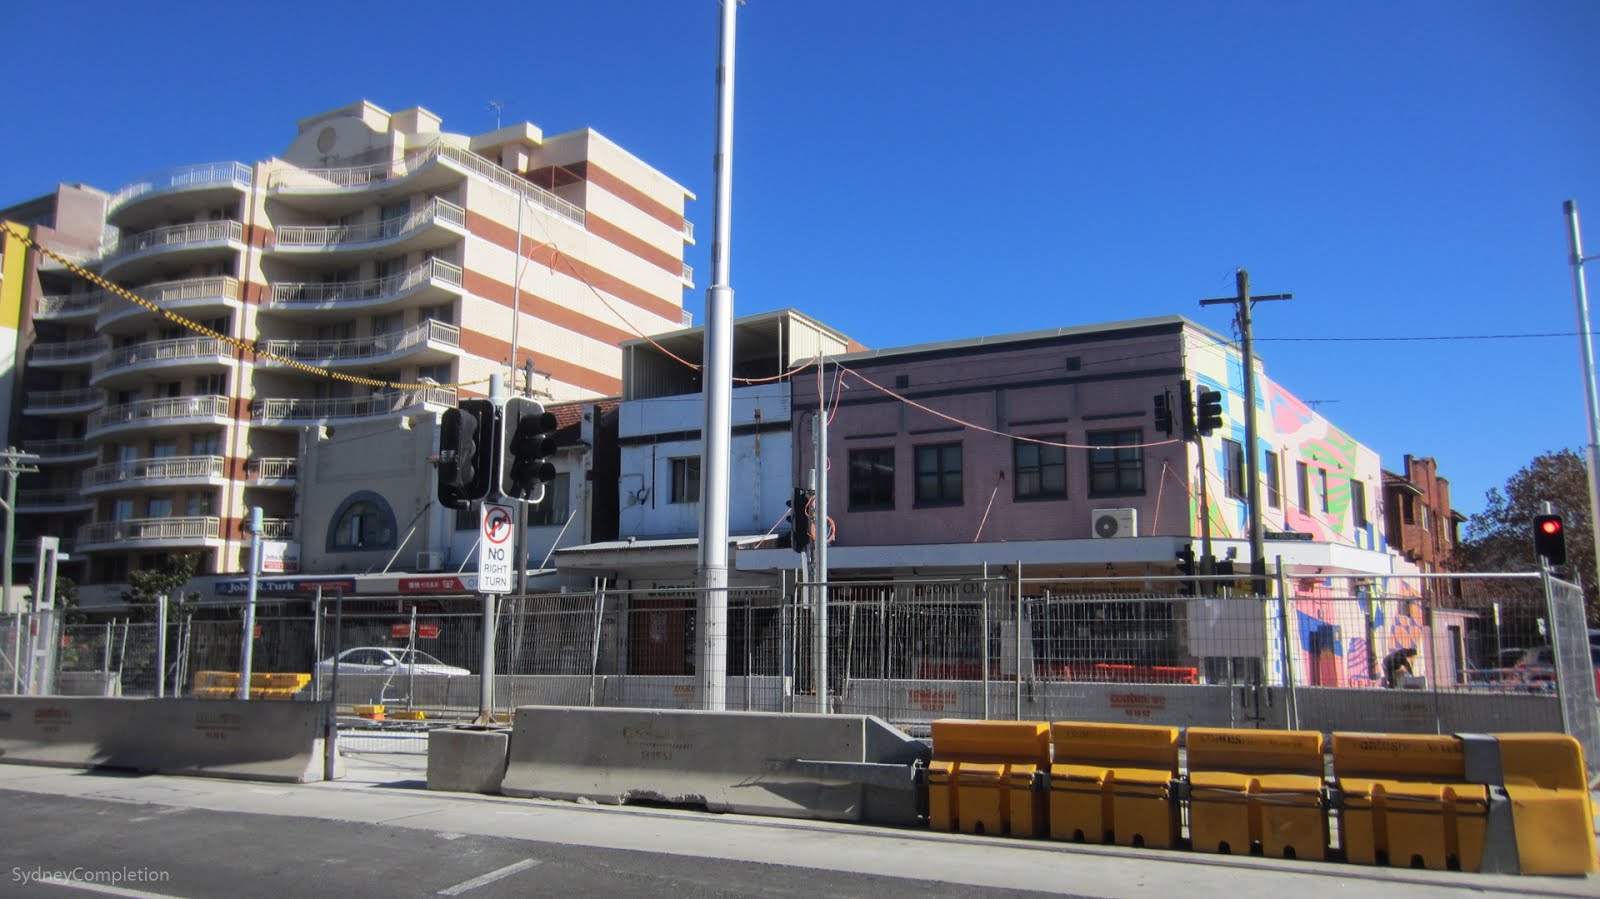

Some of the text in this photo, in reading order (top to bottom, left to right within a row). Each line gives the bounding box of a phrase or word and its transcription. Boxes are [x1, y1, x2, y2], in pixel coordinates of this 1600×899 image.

[488, 547, 505, 561] NO
[484, 563, 508, 574] RIGHT
[485, 576, 507, 587] TURN
[228, 583, 251, 593] Joh
